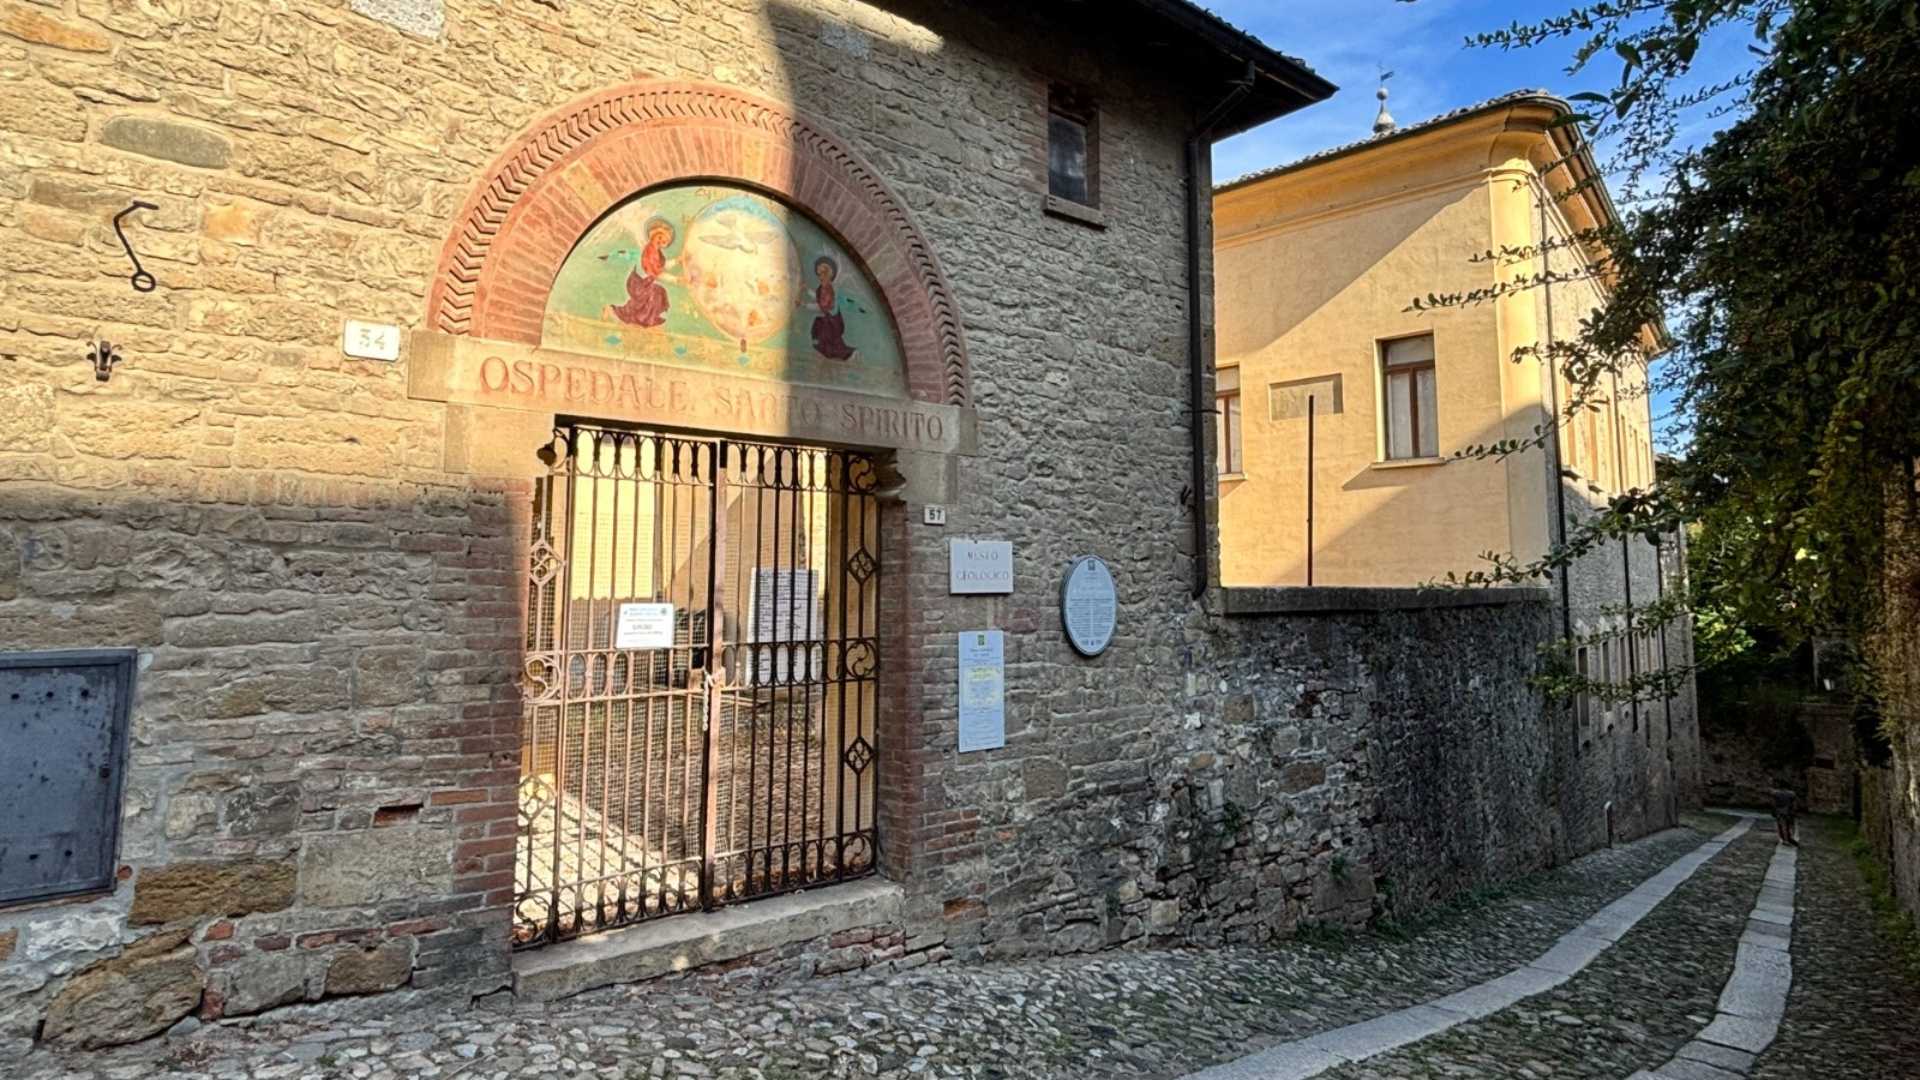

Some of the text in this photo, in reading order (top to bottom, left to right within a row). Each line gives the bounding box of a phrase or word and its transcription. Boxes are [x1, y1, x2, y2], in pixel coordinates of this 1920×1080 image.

[479, 356, 943, 441] OSPEDALE SANTO SPIRITO
[929, 509, 942, 520] 57
